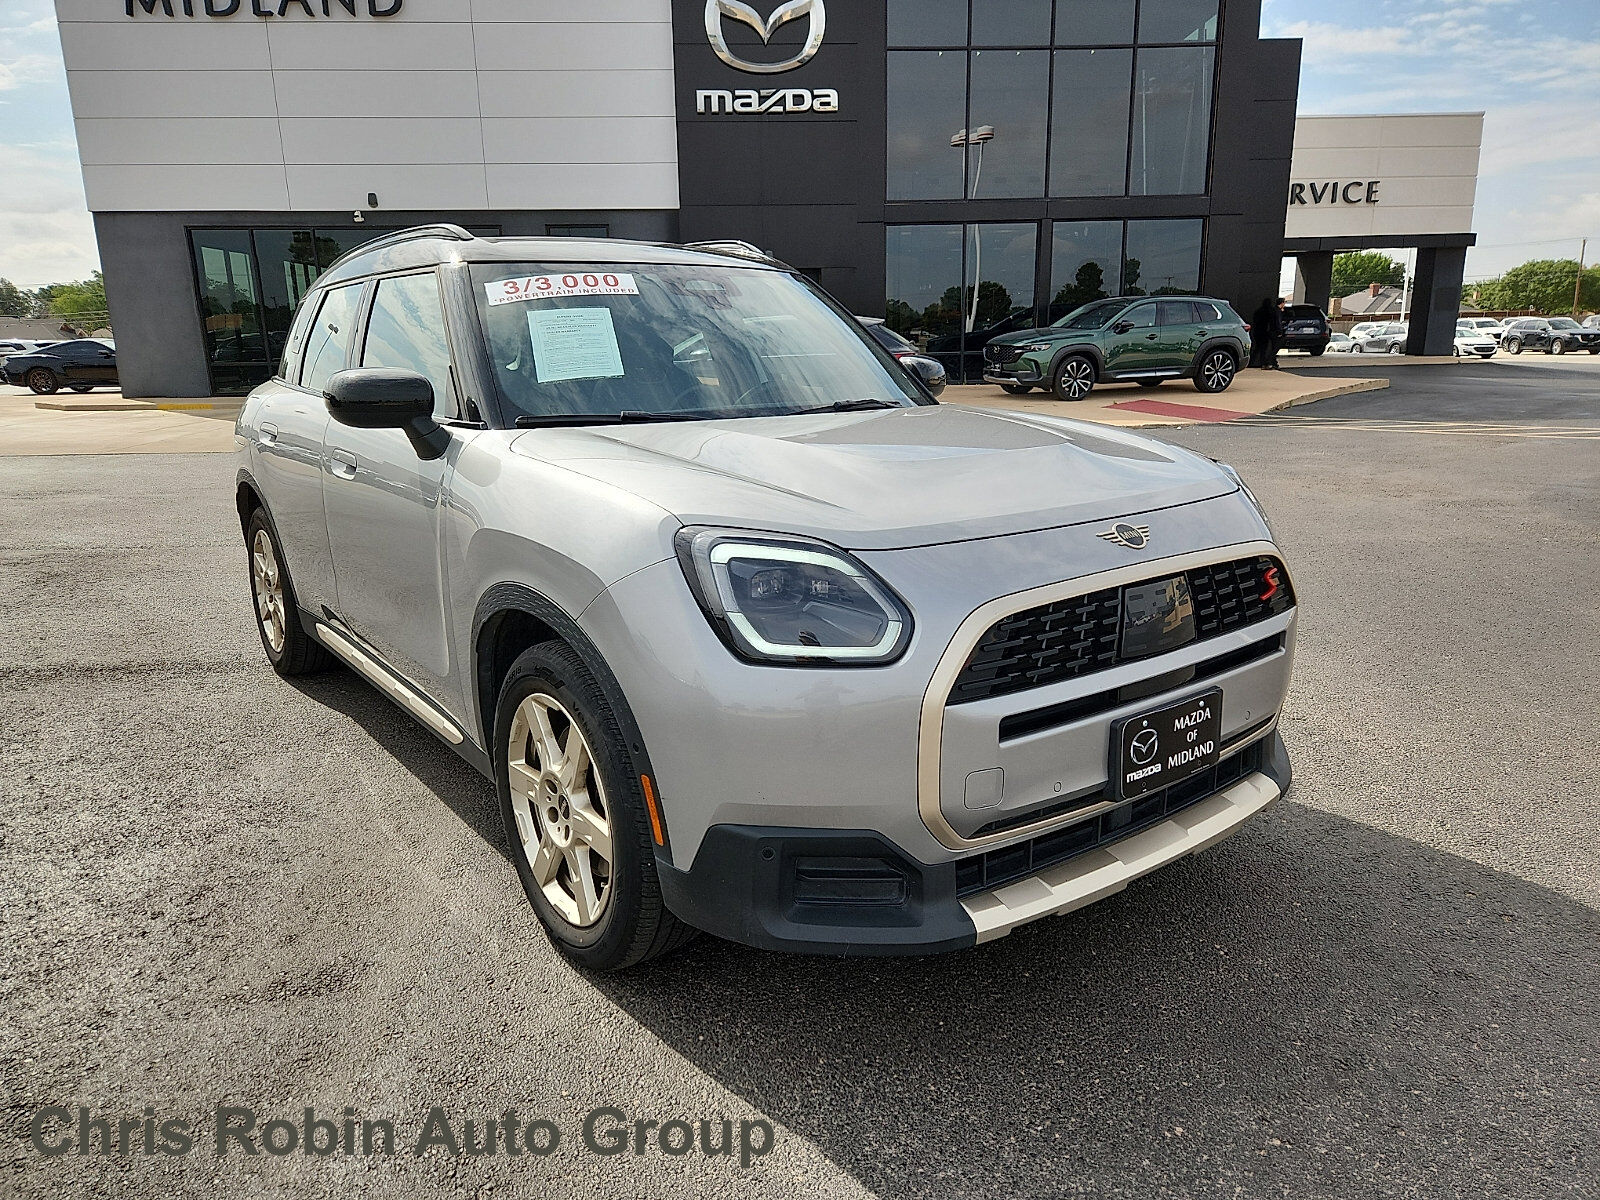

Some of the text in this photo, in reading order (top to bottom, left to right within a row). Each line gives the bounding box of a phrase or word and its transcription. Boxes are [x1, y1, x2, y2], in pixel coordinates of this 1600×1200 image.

[503, 274, 619, 295] 3/3,000
[1173, 707, 1212, 732] MAZDA
[1186, 729, 1198, 743] OF
[1167, 740, 1214, 770] MIDLAND
[1126, 763, 1162, 783] mazda
